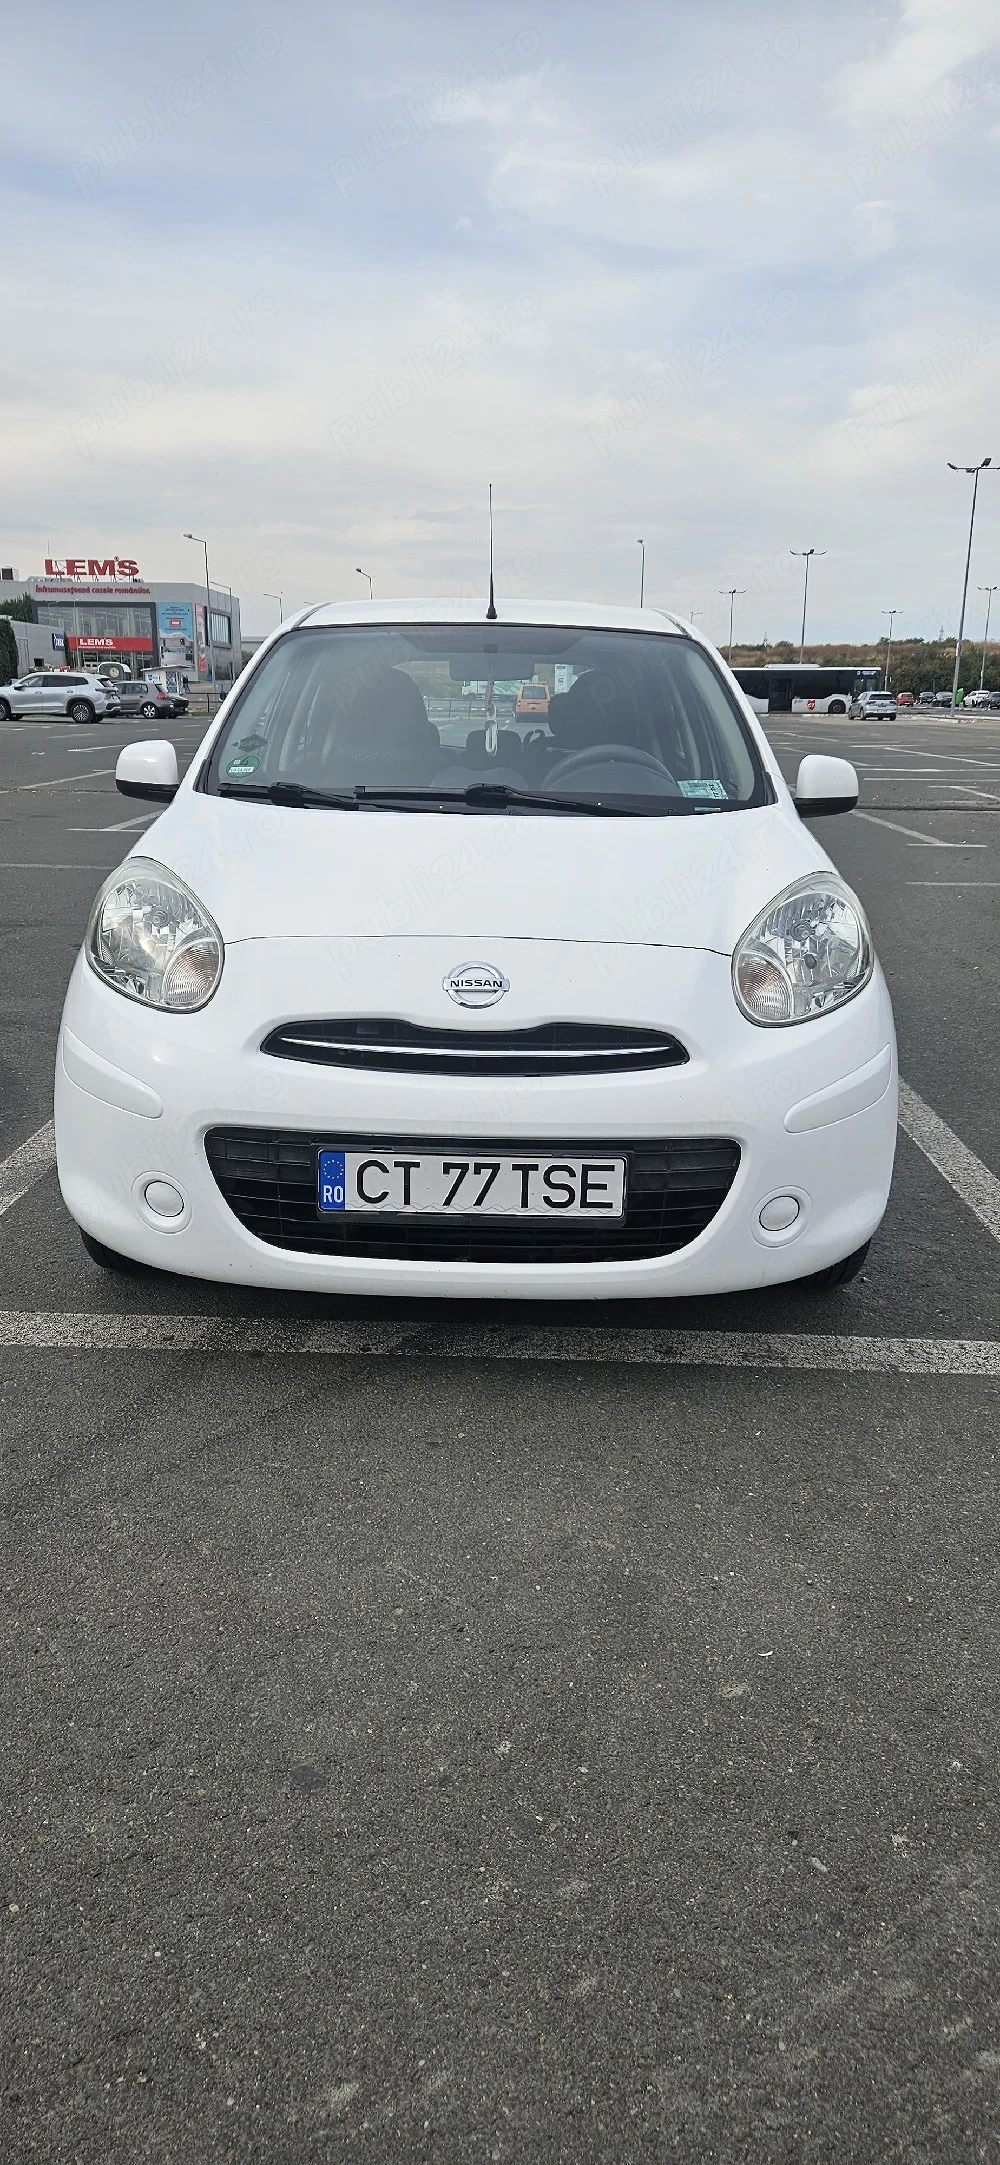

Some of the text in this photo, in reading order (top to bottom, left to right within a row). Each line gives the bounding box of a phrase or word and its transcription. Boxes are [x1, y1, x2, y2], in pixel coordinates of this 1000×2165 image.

[450, 979, 503, 988] NISSAN
[323, 1184, 344, 1204] RO
[356, 1159, 616, 1209] CT 77 TSE
